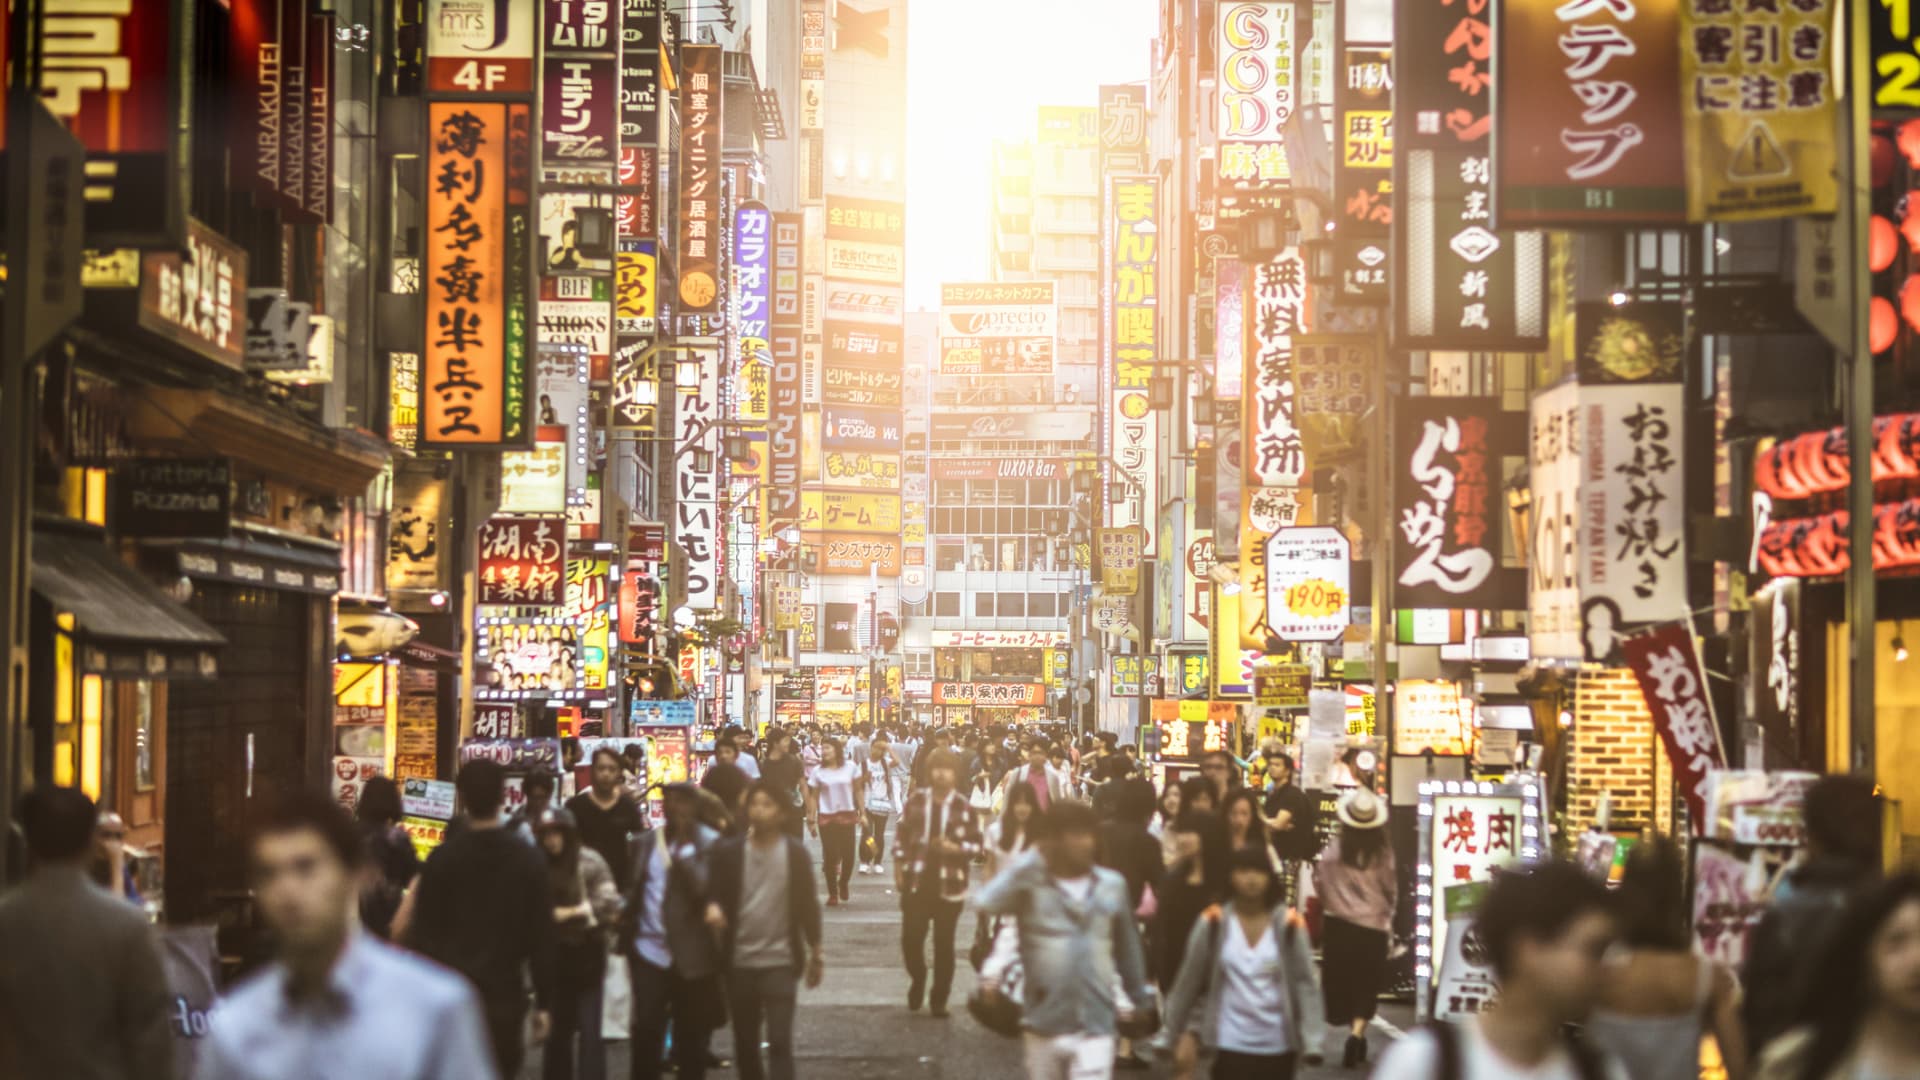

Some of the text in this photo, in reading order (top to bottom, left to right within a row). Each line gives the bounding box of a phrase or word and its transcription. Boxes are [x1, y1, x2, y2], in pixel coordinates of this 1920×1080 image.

[1694, 24, 1824, 65] 客引き
[453, 60, 507, 91] 4F
[1694, 71, 1824, 111] に注意
[258, 42, 280, 191] ANRAKUTEI
[561, 62, 594, 133] エデン
[688, 71, 709, 258] 個室ダイニング居酒屋
[738, 209, 768, 318] カラオケ
[1115, 183, 1154, 388] まんが喫茶
[1256, 259, 1304, 475] 無料案内所
[825, 452, 898, 479] まんが喫茶
[997, 459, 1034, 477] LUXOR
[1035, 459, 1056, 477] Bar
[1121, 421, 1147, 523] マンボー
[825, 504, 872, 527] ゲーム
[481, 519, 561, 565] 湖南
[1287, 584, 1342, 609] 190円
[818, 681, 854, 696] ゲーム
[942, 684, 1025, 700] 無料案内所
